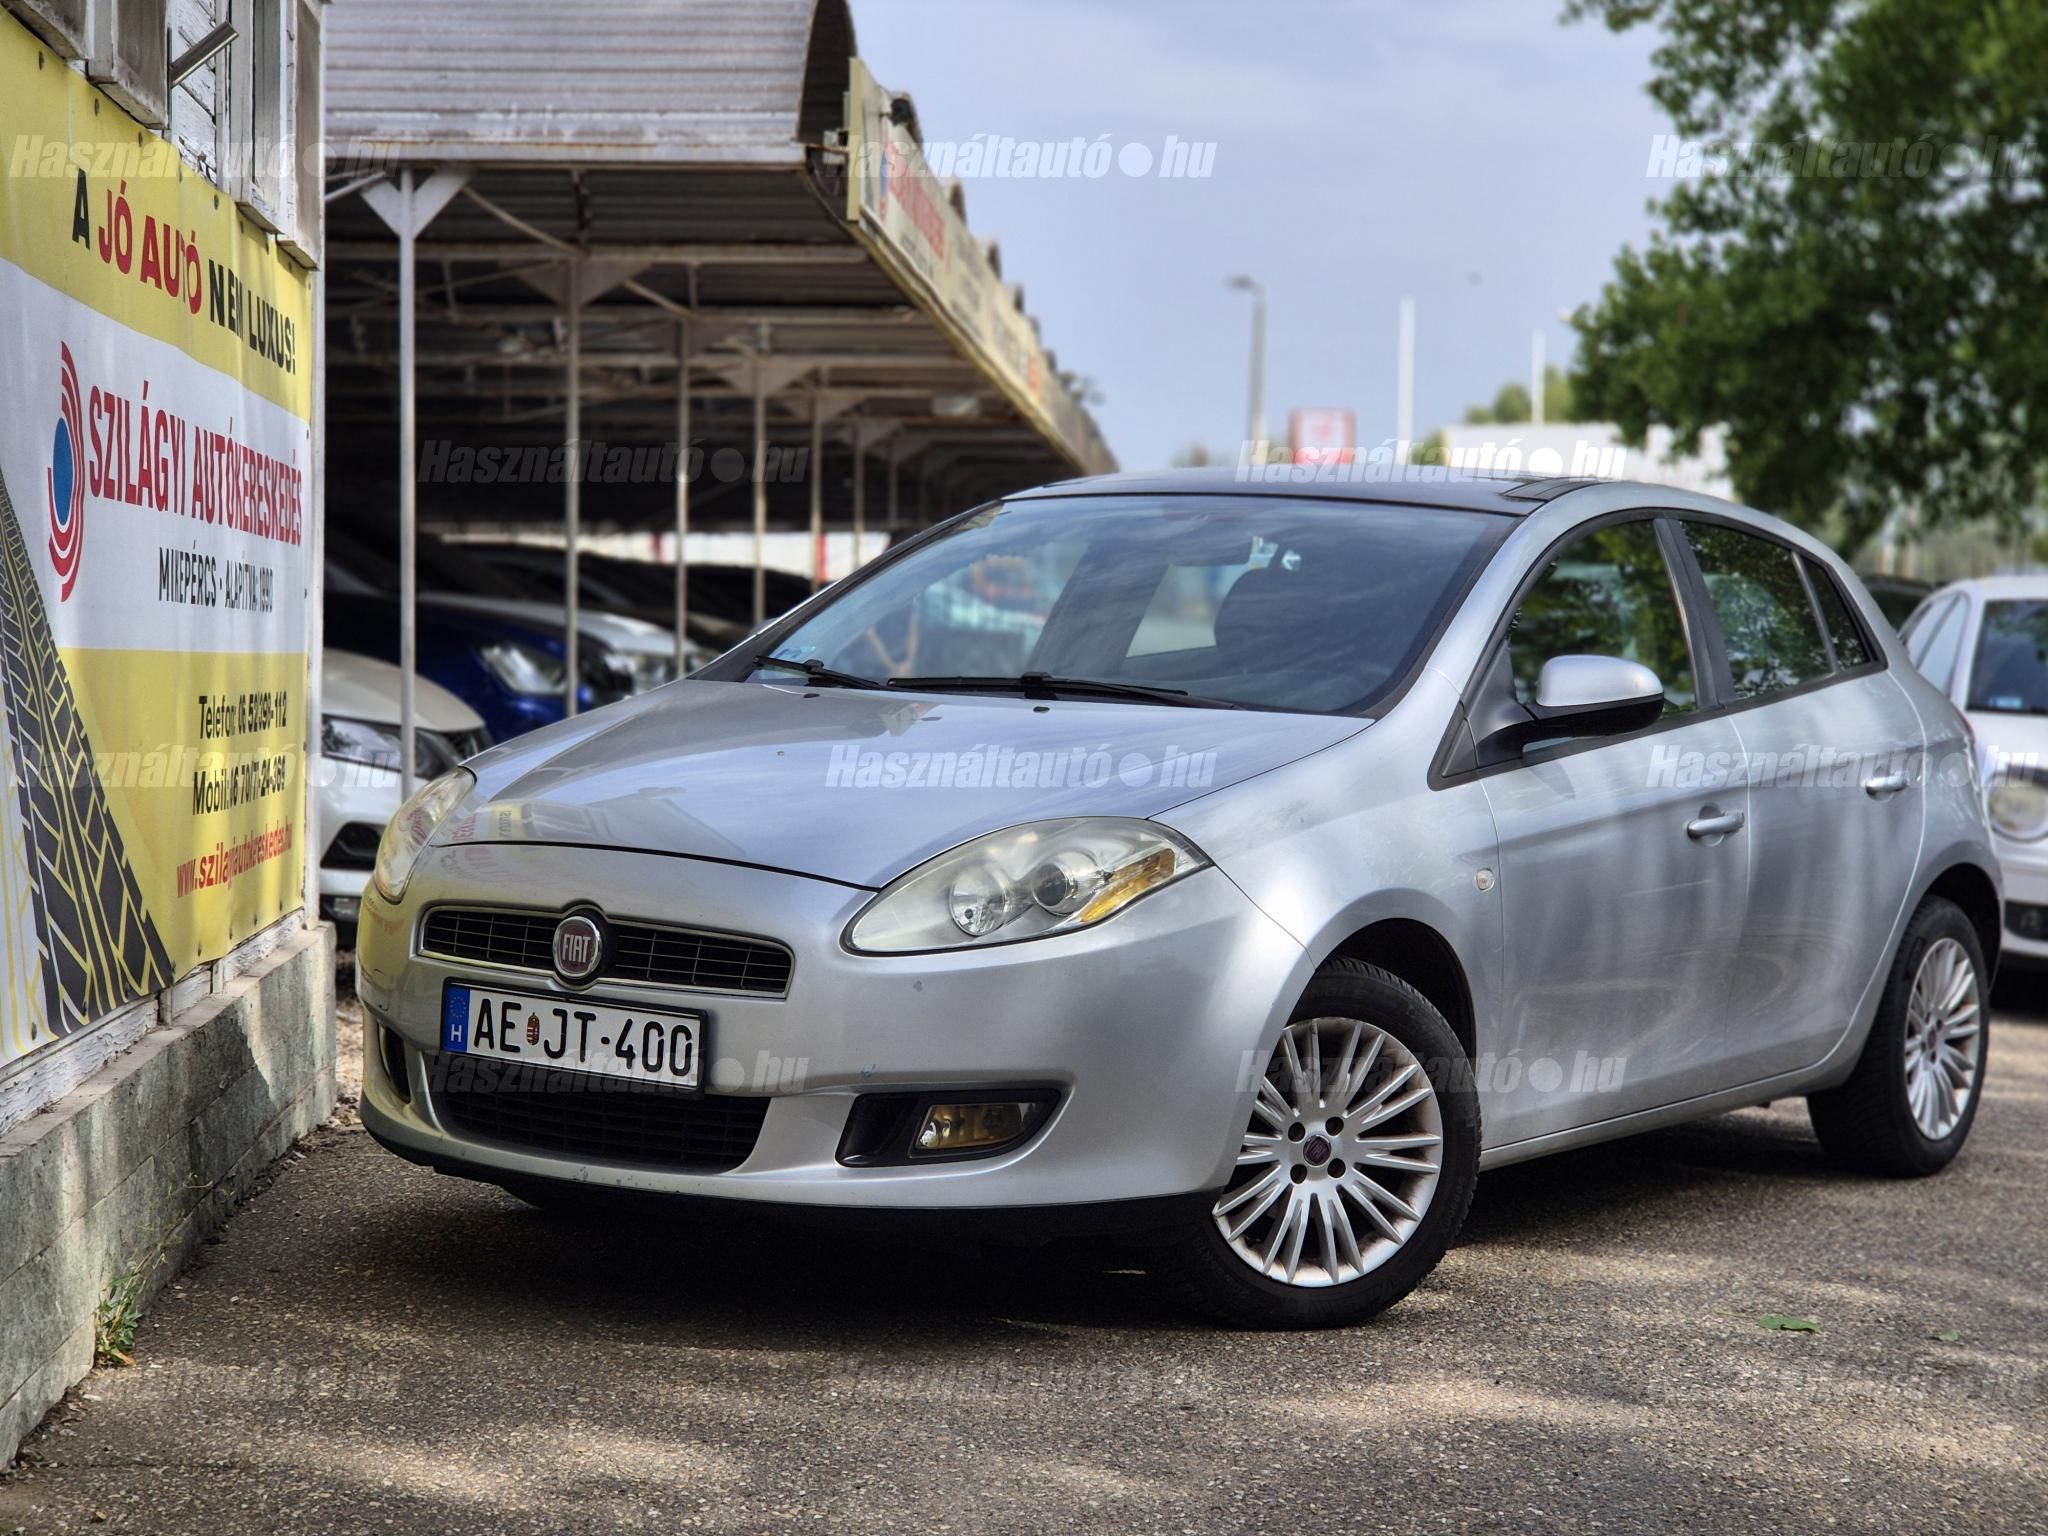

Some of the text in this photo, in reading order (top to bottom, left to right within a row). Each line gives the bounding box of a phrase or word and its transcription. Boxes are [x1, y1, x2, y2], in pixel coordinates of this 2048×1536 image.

[72, 168, 296, 375] A JÓ AUTÓ NEM LUXUS!
[89, 380, 303, 548] SZILÁGYI AUTÓKERESKEDÉS
[158, 539, 217, 608] MIKEPÉRCS
[562, 933, 592, 964] FIAT
[450, 1024, 463, 1044] H
[473, 998, 522, 1053] AE
